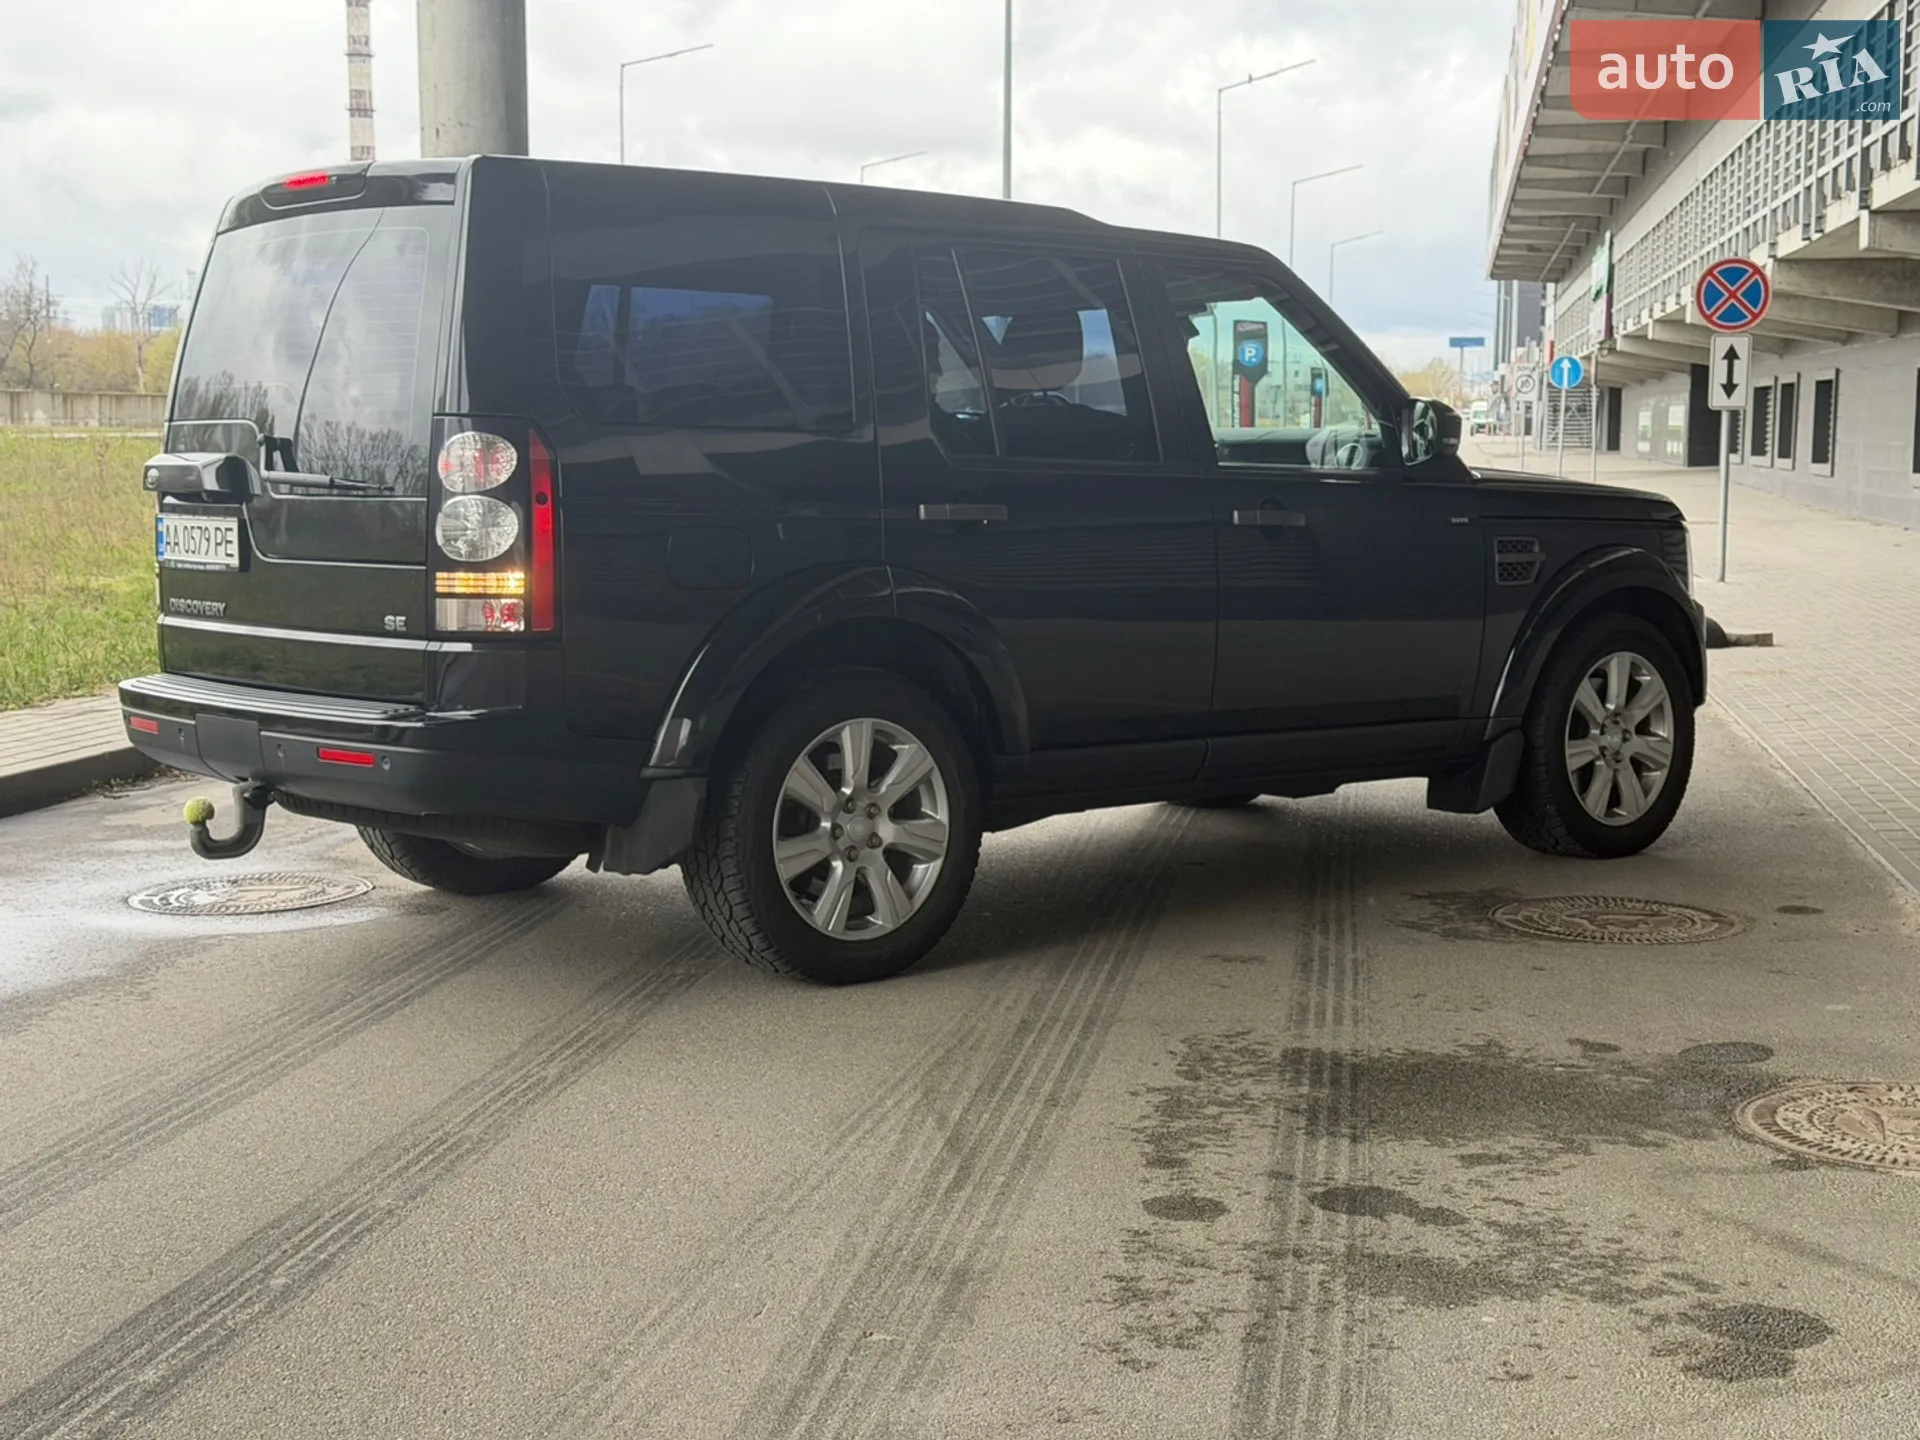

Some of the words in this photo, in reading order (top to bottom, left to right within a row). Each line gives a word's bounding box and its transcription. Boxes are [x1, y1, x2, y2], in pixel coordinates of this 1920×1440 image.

[165, 524, 181, 554] AA
[183, 525, 211, 557] 0579
[214, 526, 235, 558] PE
[169, 597, 227, 617] DISCOVERY
[384, 614, 407, 632] SE
